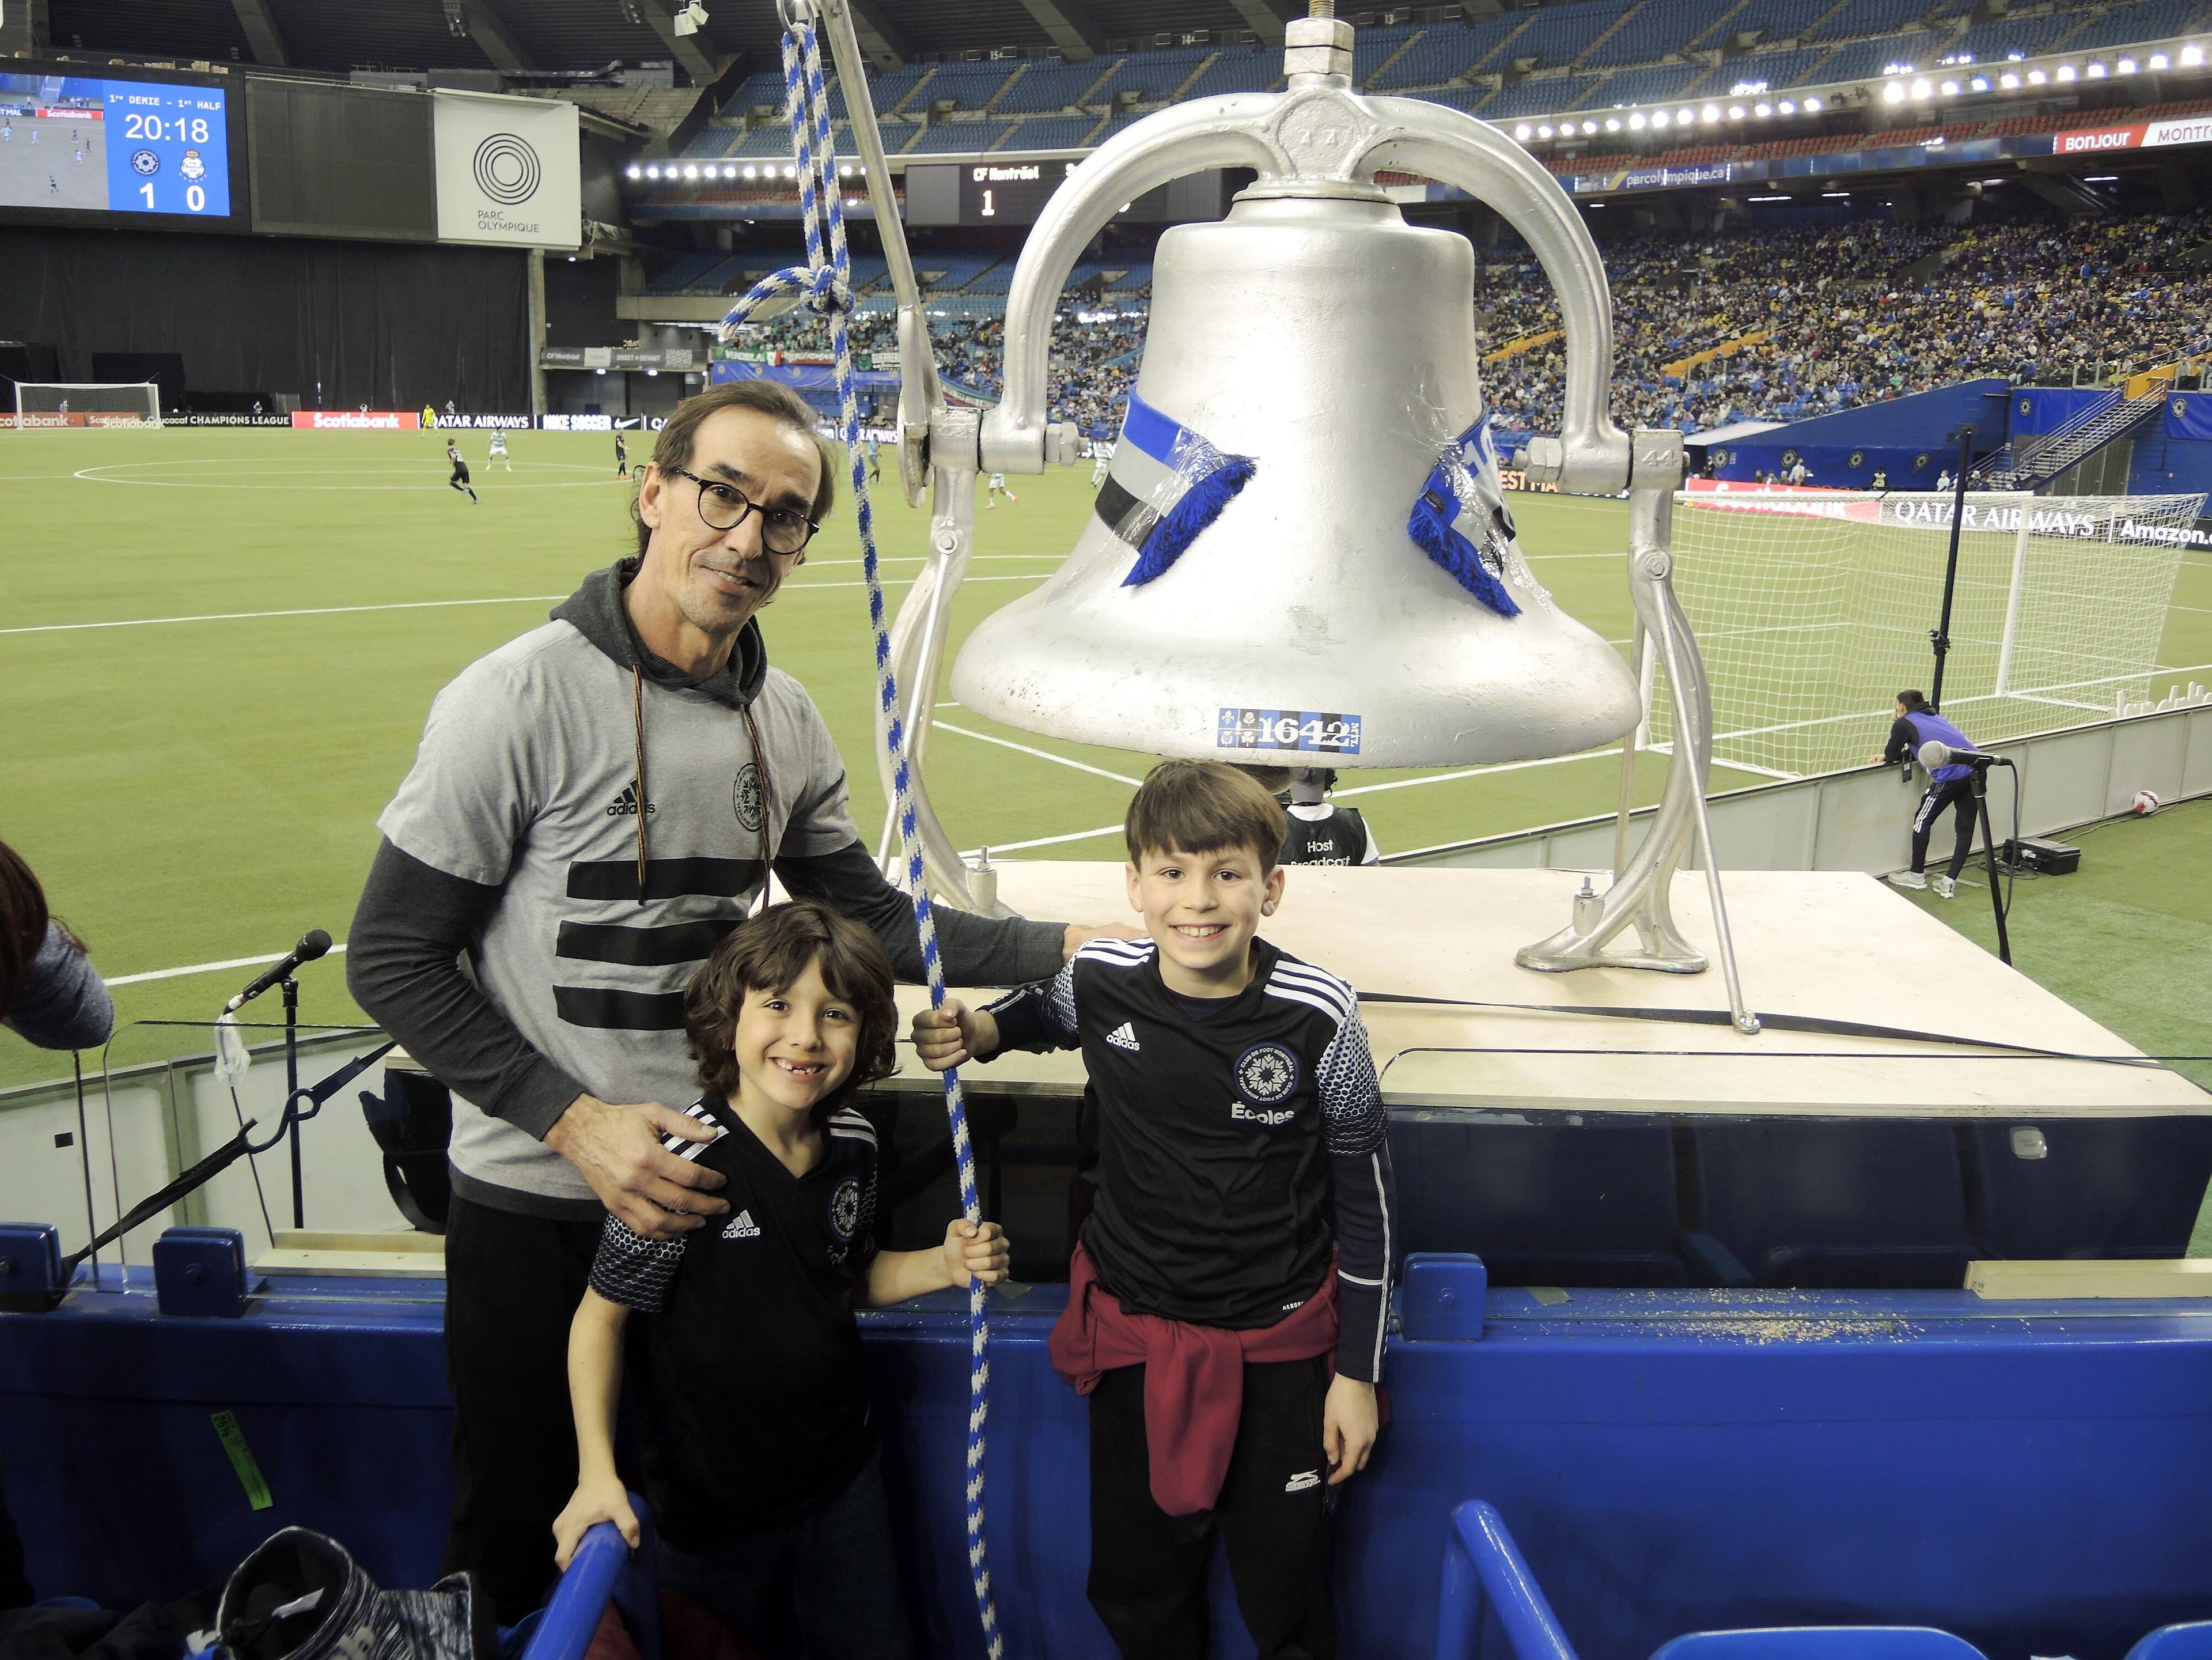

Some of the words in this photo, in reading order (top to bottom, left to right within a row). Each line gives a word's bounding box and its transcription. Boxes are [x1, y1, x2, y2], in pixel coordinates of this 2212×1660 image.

[128, 95, 161, 106] DEMIE
[197, 101, 222, 111] HALF
[47, 110, 93, 119] Scotiabank
[125, 114, 209, 143] 20:18
[973, 167, 988, 181] CF
[1626, 169, 1725, 188] parcolympique.ca
[139, 182, 155, 209] 1
[186, 184, 206, 211] 0
[981, 190, 995, 216] 1
[478, 210, 504, 221] PARC
[478, 221, 540, 234] OLYMPIQUE
[190, 415, 250, 425] CHAMPIONS
[252, 415, 289, 425] LEAGUE
[313, 413, 400, 429] Scotiabank
[474, 414, 529, 429] AIRWAYS
[543, 414, 569, 430] NIKE
[570, 414, 612, 431] SOCCER
[1895, 501, 1977, 527] QATAR
[1983, 504, 2096, 538] AIRWAYS
[1257, 716, 1351, 747] 1642
[607, 801, 656, 816] adids
[1306, 839, 1334, 853] Host
[1106, 1033, 1141, 1052] adidas
[1240, 1054, 1252, 1068] CLUB
[1231, 1101, 1295, 1125] Écoles
[722, 1225, 760, 1239] adidas
